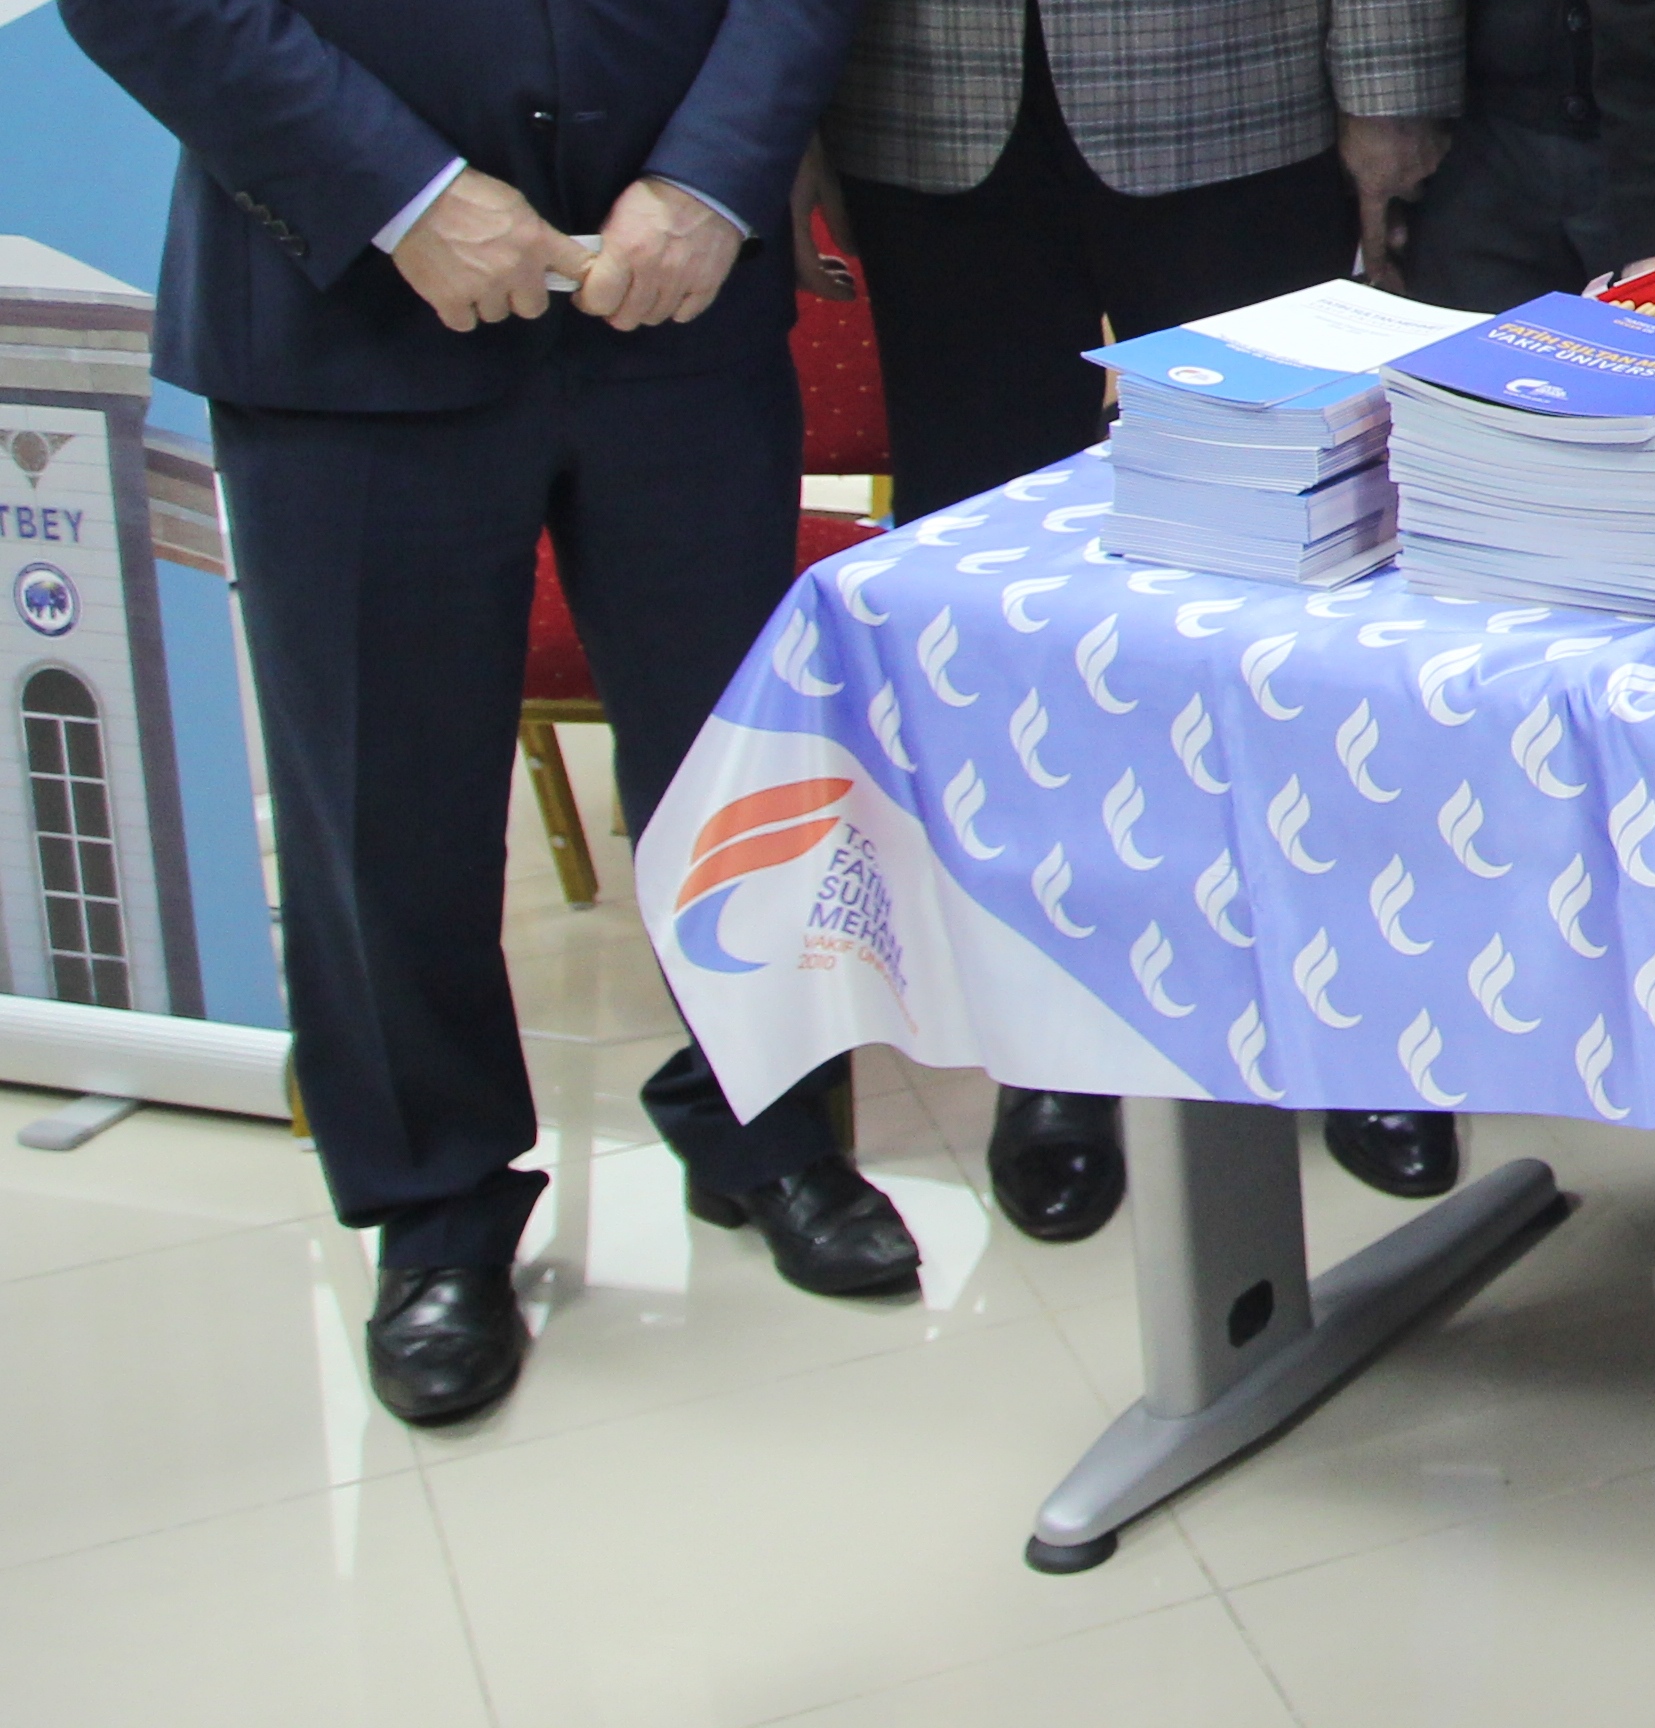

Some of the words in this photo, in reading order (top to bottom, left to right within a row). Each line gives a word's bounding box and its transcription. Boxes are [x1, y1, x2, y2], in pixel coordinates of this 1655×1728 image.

[1487, 329, 1557, 353] VAKIF
[1557, 340, 1638, 365] SULTAN
[0, 505, 83, 543] TBEY
